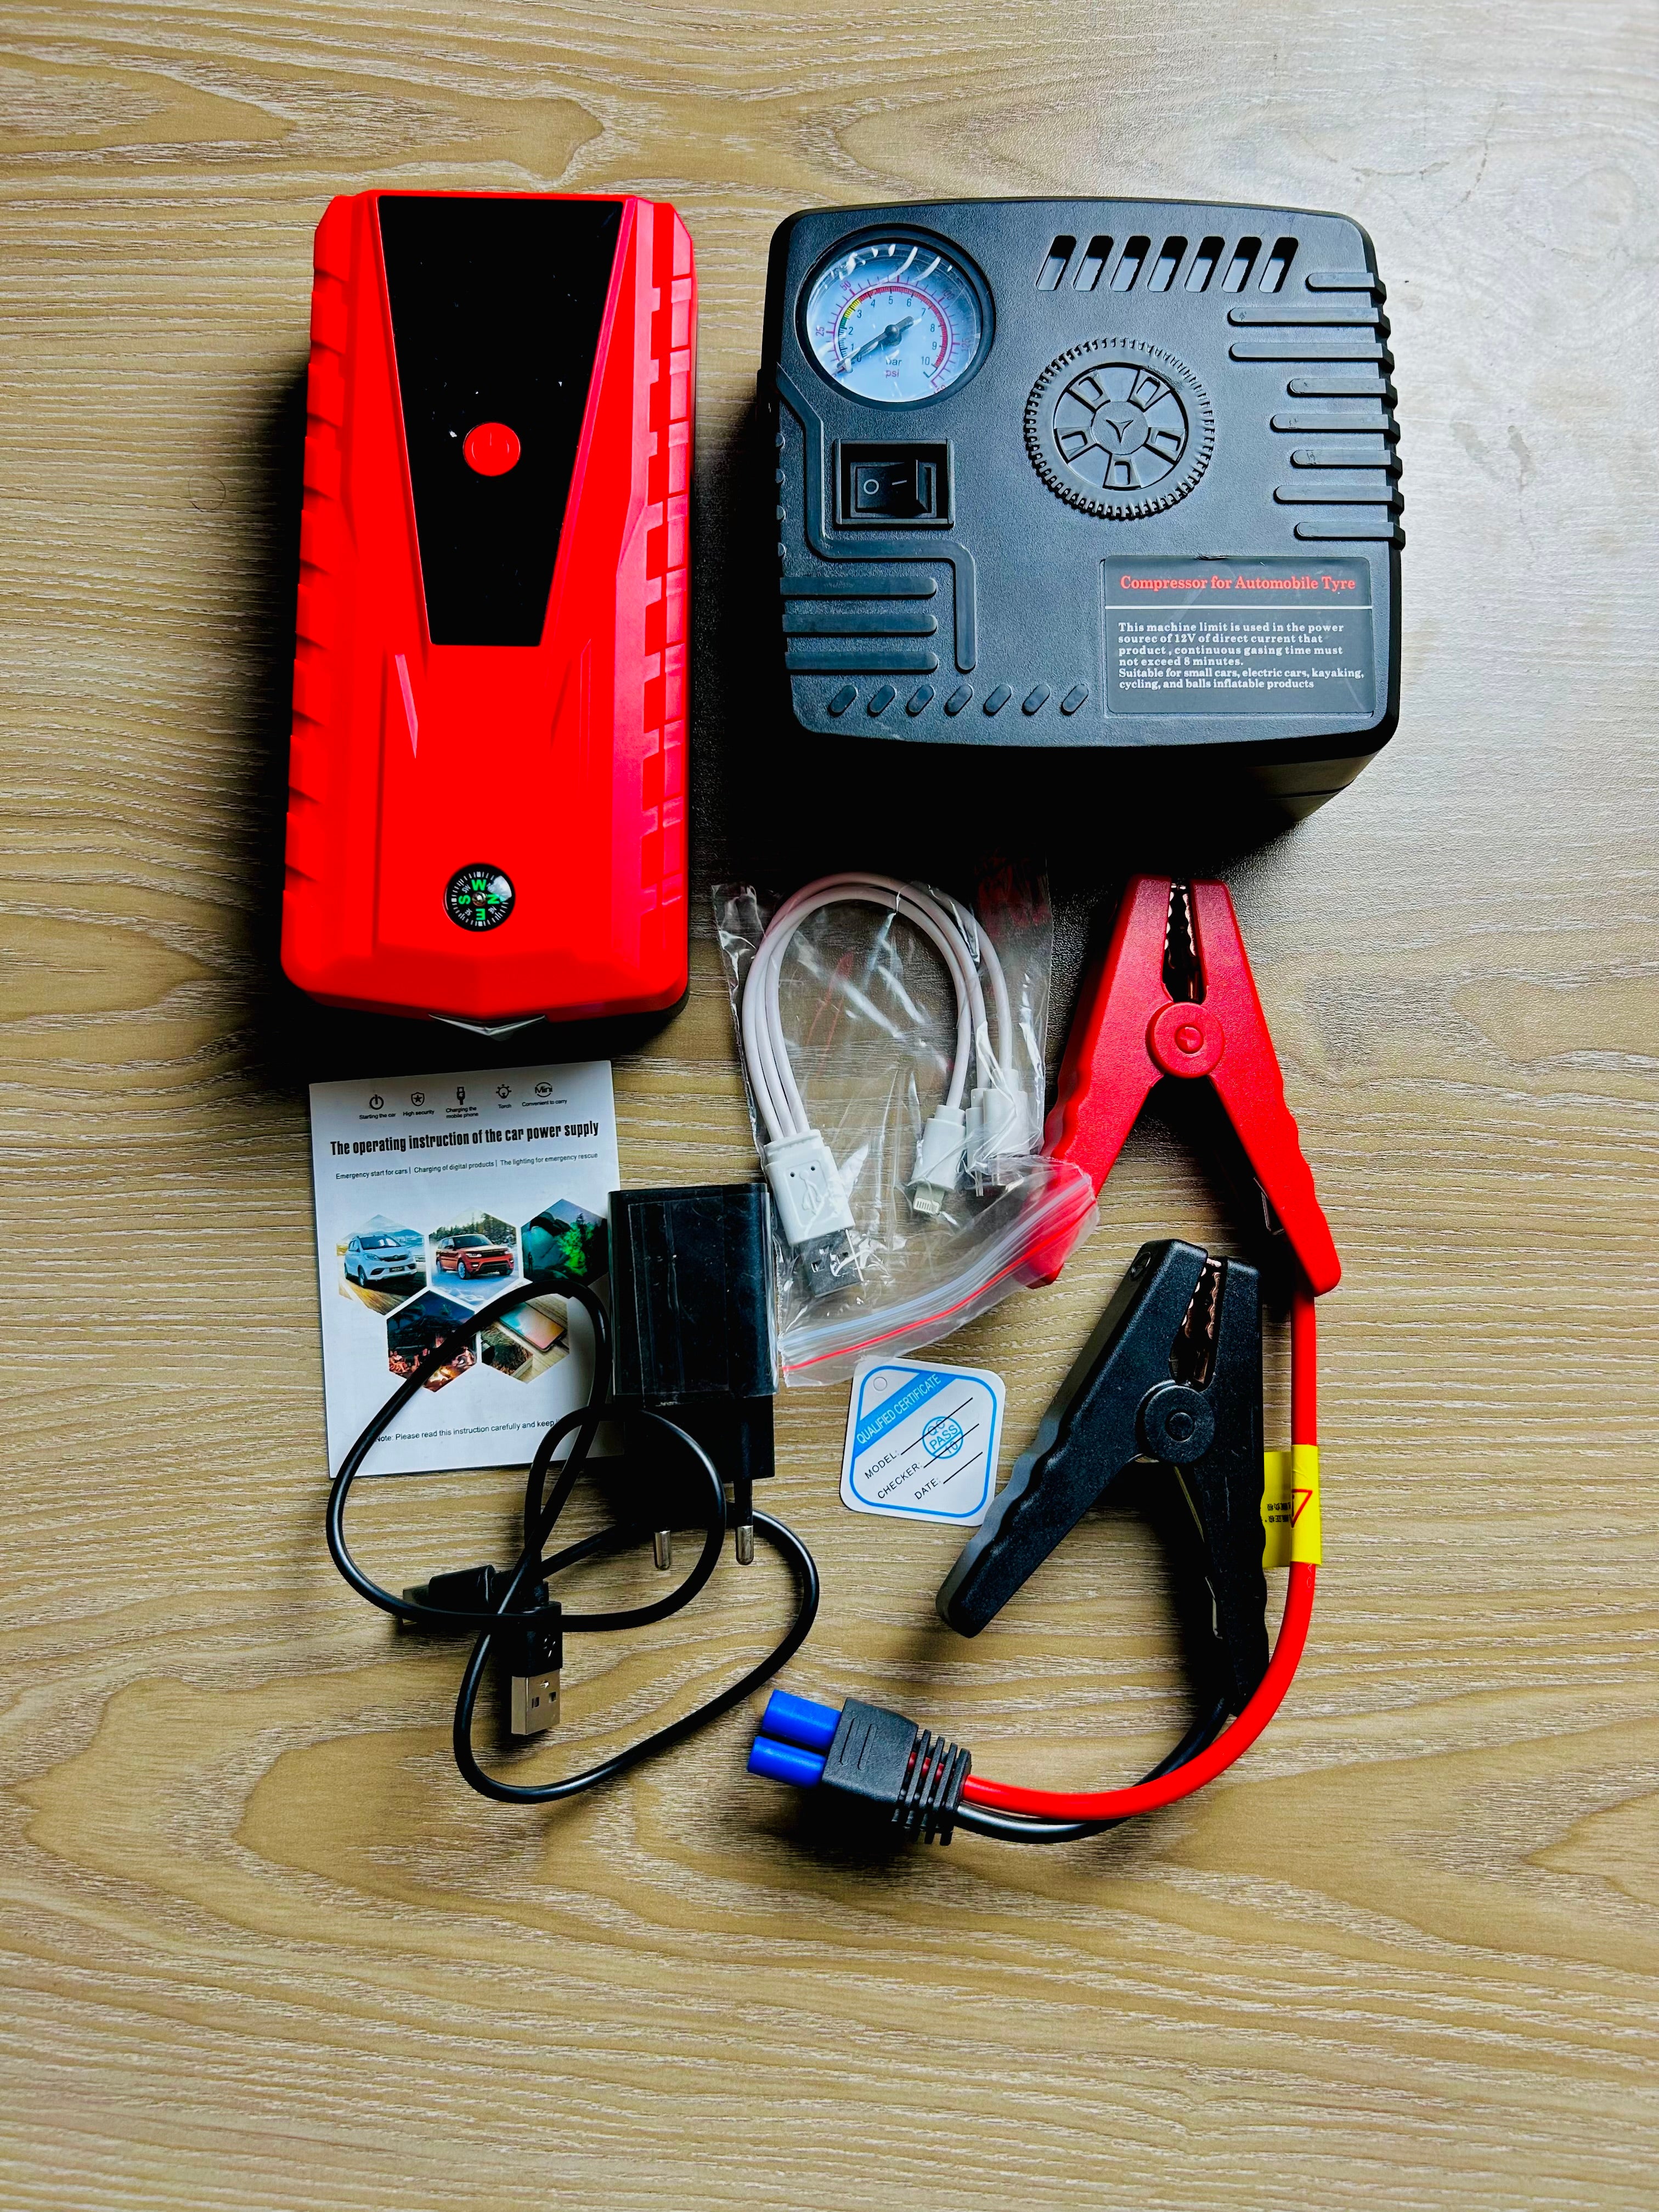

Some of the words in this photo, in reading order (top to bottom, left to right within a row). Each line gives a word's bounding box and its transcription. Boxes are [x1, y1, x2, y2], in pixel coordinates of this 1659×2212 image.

[840, 281, 851, 291] 50
[871, 300, 876, 308] 4
[888, 296, 894, 304] 5
[906, 298, 912, 307] 6
[857, 310, 862, 318] 3
[816, 326, 825, 336] 25
[930, 324, 935, 332] 8
[932, 341, 937, 350] 9
[885, 358, 902, 366] bar
[921, 356, 930, 365] 10
[885, 369, 899, 379] psi
[1121, 575, 1207, 591] Compressor
[1211, 575, 1232, 590] for
[1235, 576, 1318, 590] Automobile
[1322, 576, 1355, 591] Tyre
[1118, 622, 1144, 632] This
[1147, 622, 1196, 632] machine
[1200, 622, 1228, 632] limit
[1231, 622, 1240, 632] is
[1243, 622, 1269, 632] used
[1273, 623, 1284, 632] in
[1286, 623, 1305, 632] the
[1308, 624, 1344, 634] power
[1160, 634, 1173, 643] of
[1175, 634, 1195, 643] 12V
[1198, 634, 1210, 643] of
[1212, 634, 1249, 643] direct
[1251, 635, 1296, 643] current
[1299, 634, 1323, 643] that
[1174, 646, 1241, 654] continuous
[1244, 646, 1282, 656] gasing
[1285, 646, 1311, 654] time
[1119, 657, 1138, 666] not
[1141, 657, 1181, 666] exceed
[1184, 657, 1190, 665] 8
[1193, 657, 1244, 665] minutes.
[1119, 668, 1164, 678] Suitable
[1166, 668, 1181, 677] for
[1184, 668, 1212, 677] small
[1215, 670, 1240, 678] cars,
[1242, 668, 1282, 677] electric
[1284, 669, 1310, 678] cars,
[1312, 668, 1364, 679] kayaking,
[1119, 679, 1161, 690] cycling,
[1163, 679, 1183, 688] and
[1186, 679, 1211, 688] balls
[1213, 679, 1265, 689] inflatable
[1267, 679, 1314, 690] products
[471, 879, 487, 890] W
[458, 895, 471, 904] S
[487, 894, 500, 904] N
[476, 909, 486, 920] E
[535, 1085, 552, 1093] Mini
[330, 1141, 350, 1155] The
[353, 1136, 406, 1154] operating
[409, 1132, 469, 1147] instruction
[472, 1130, 482, 1144] of
[485, 1128, 503, 1143] the
[505, 1128, 524, 1142] car
[527, 1126, 561, 1143] power
[564, 1121, 599, 1137] supply
[449, 1163, 467, 1171] digital
[856, 1409, 895, 1444] QUALIFIED
[895, 1373, 941, 1414] CERTIFICATE
[453, 1425, 489, 1435] instruction
[491, 1423, 520, 1431] carefully
[928, 1420, 945, 1435] QC
[930, 1425, 957, 1449] PASS
[865, 1450, 900, 1479] MODEL:
[878, 1462, 923, 1499] CHECKER:
[914, 1478, 941, 1500] DATE:
